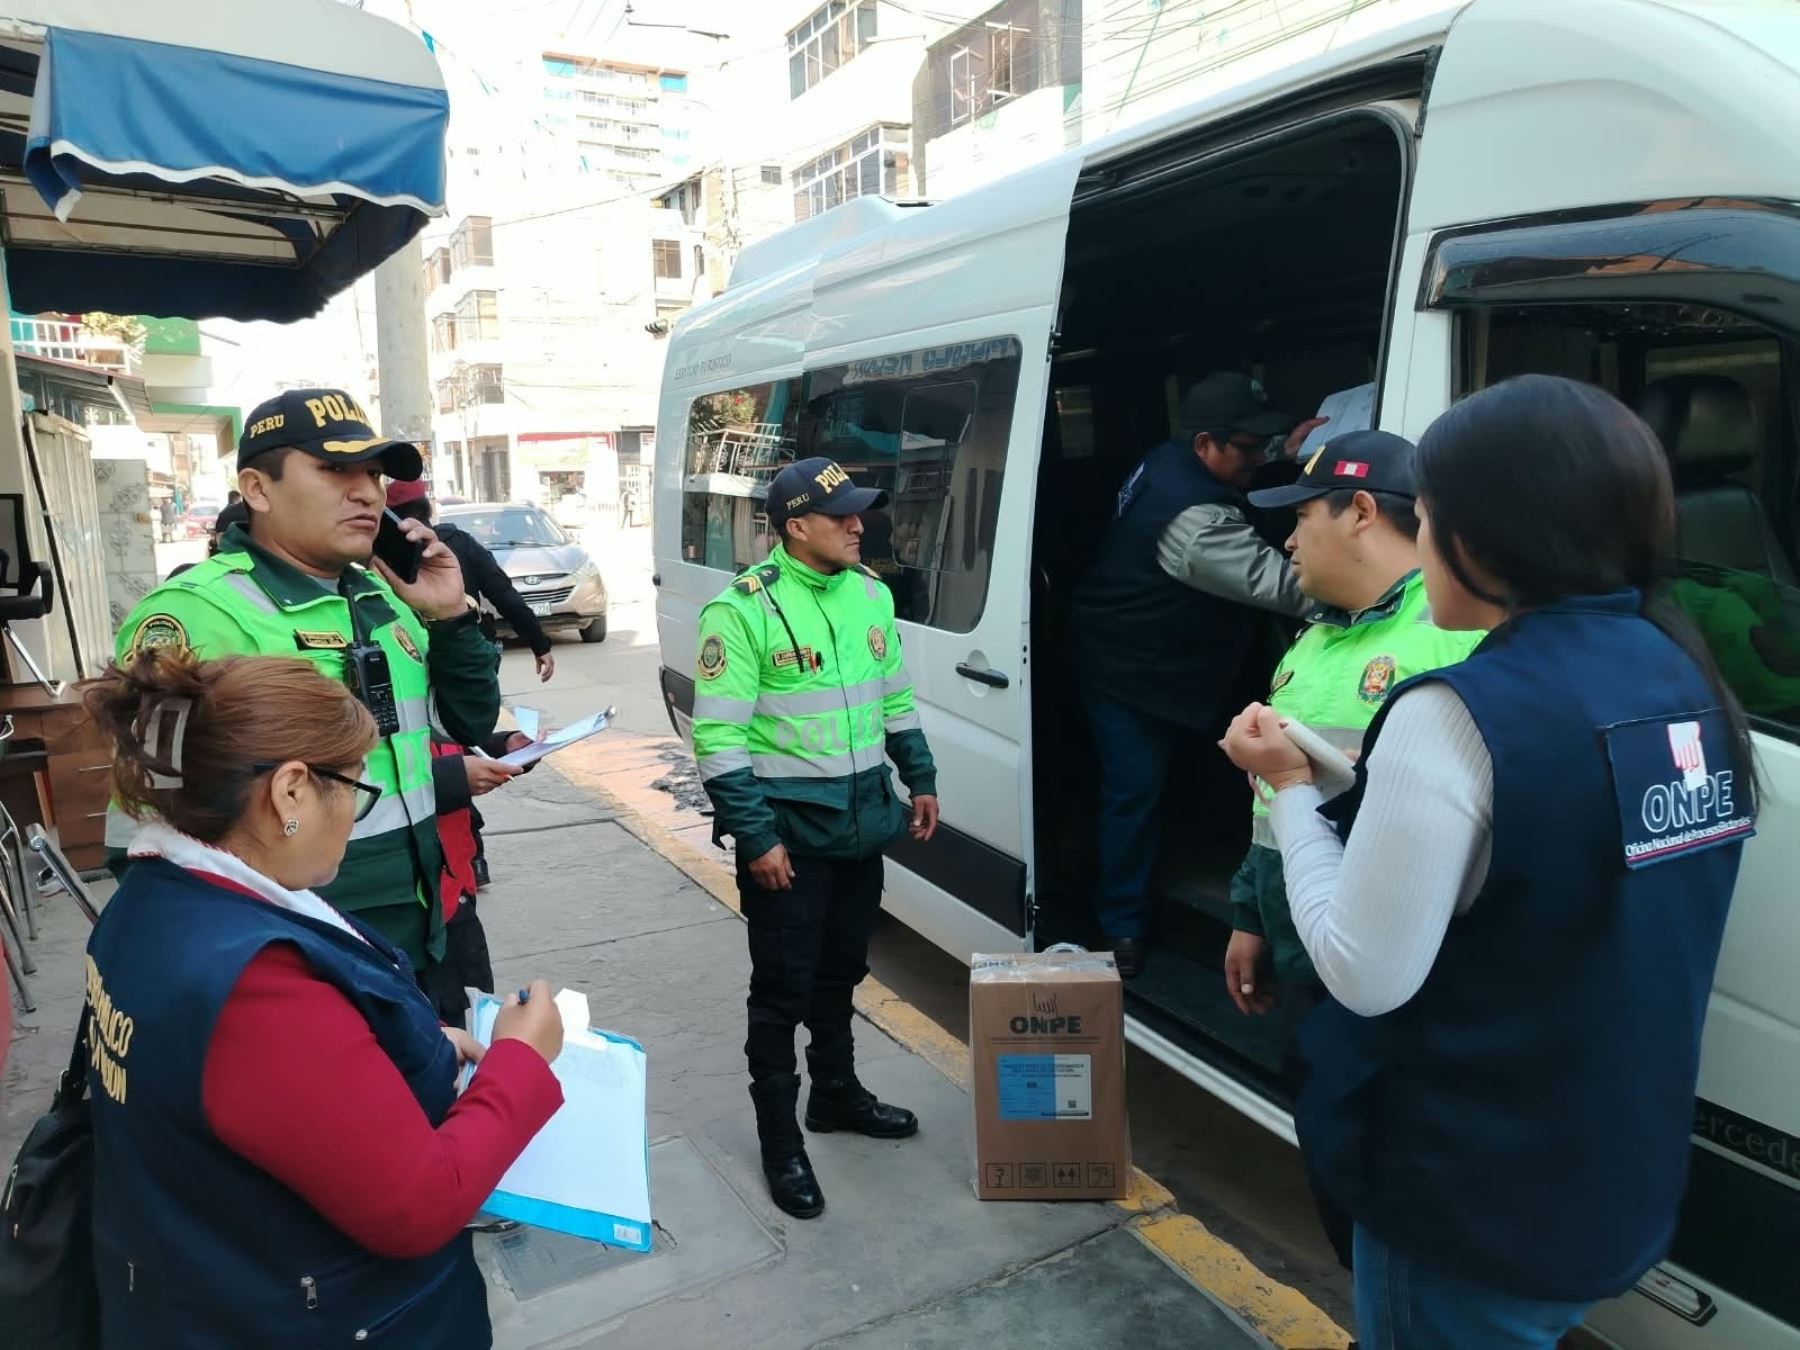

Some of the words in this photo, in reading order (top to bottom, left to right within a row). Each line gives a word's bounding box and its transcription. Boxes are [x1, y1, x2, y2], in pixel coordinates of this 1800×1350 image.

[250, 414, 285, 438] PERU
[786, 493, 810, 510] PERU
[1641, 770, 1734, 833] ONPE
[1010, 1016, 1082, 1034] ONPE
